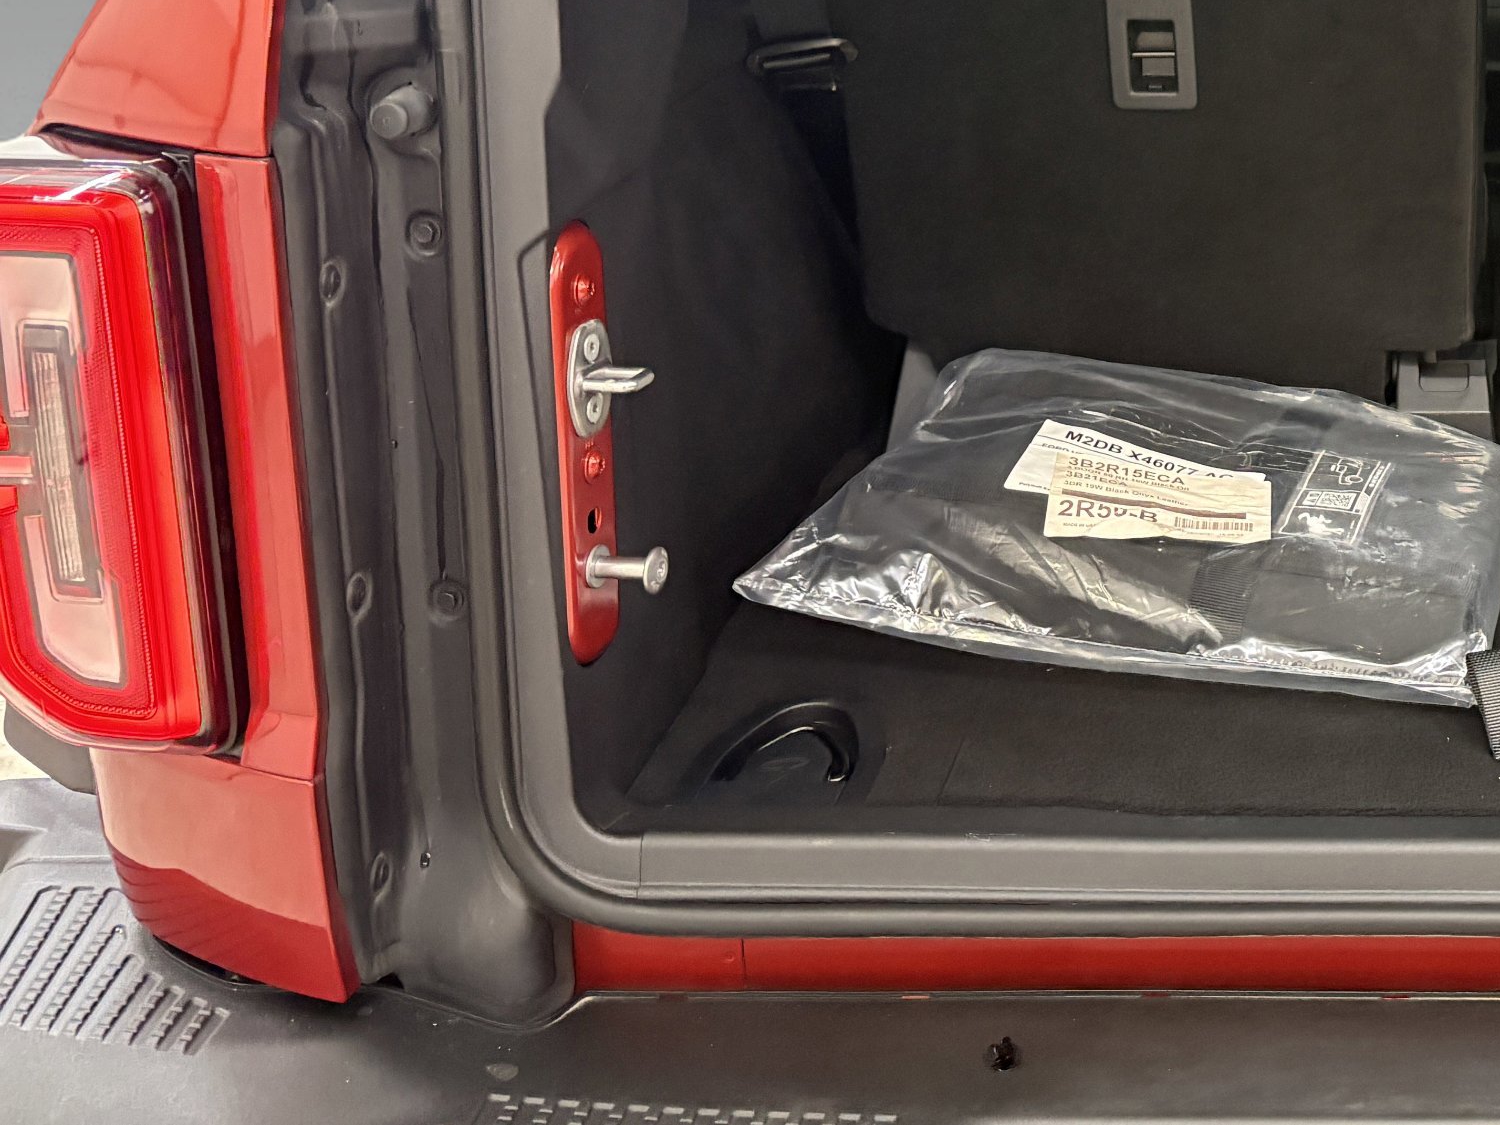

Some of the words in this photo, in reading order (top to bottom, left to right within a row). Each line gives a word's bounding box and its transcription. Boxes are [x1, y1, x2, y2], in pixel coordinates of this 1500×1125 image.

[1065, 430, 1123, 454] M2DB
[1128, 450, 1199, 476] X46077
[1068, 456, 1185, 486] 3B2R15ECA
